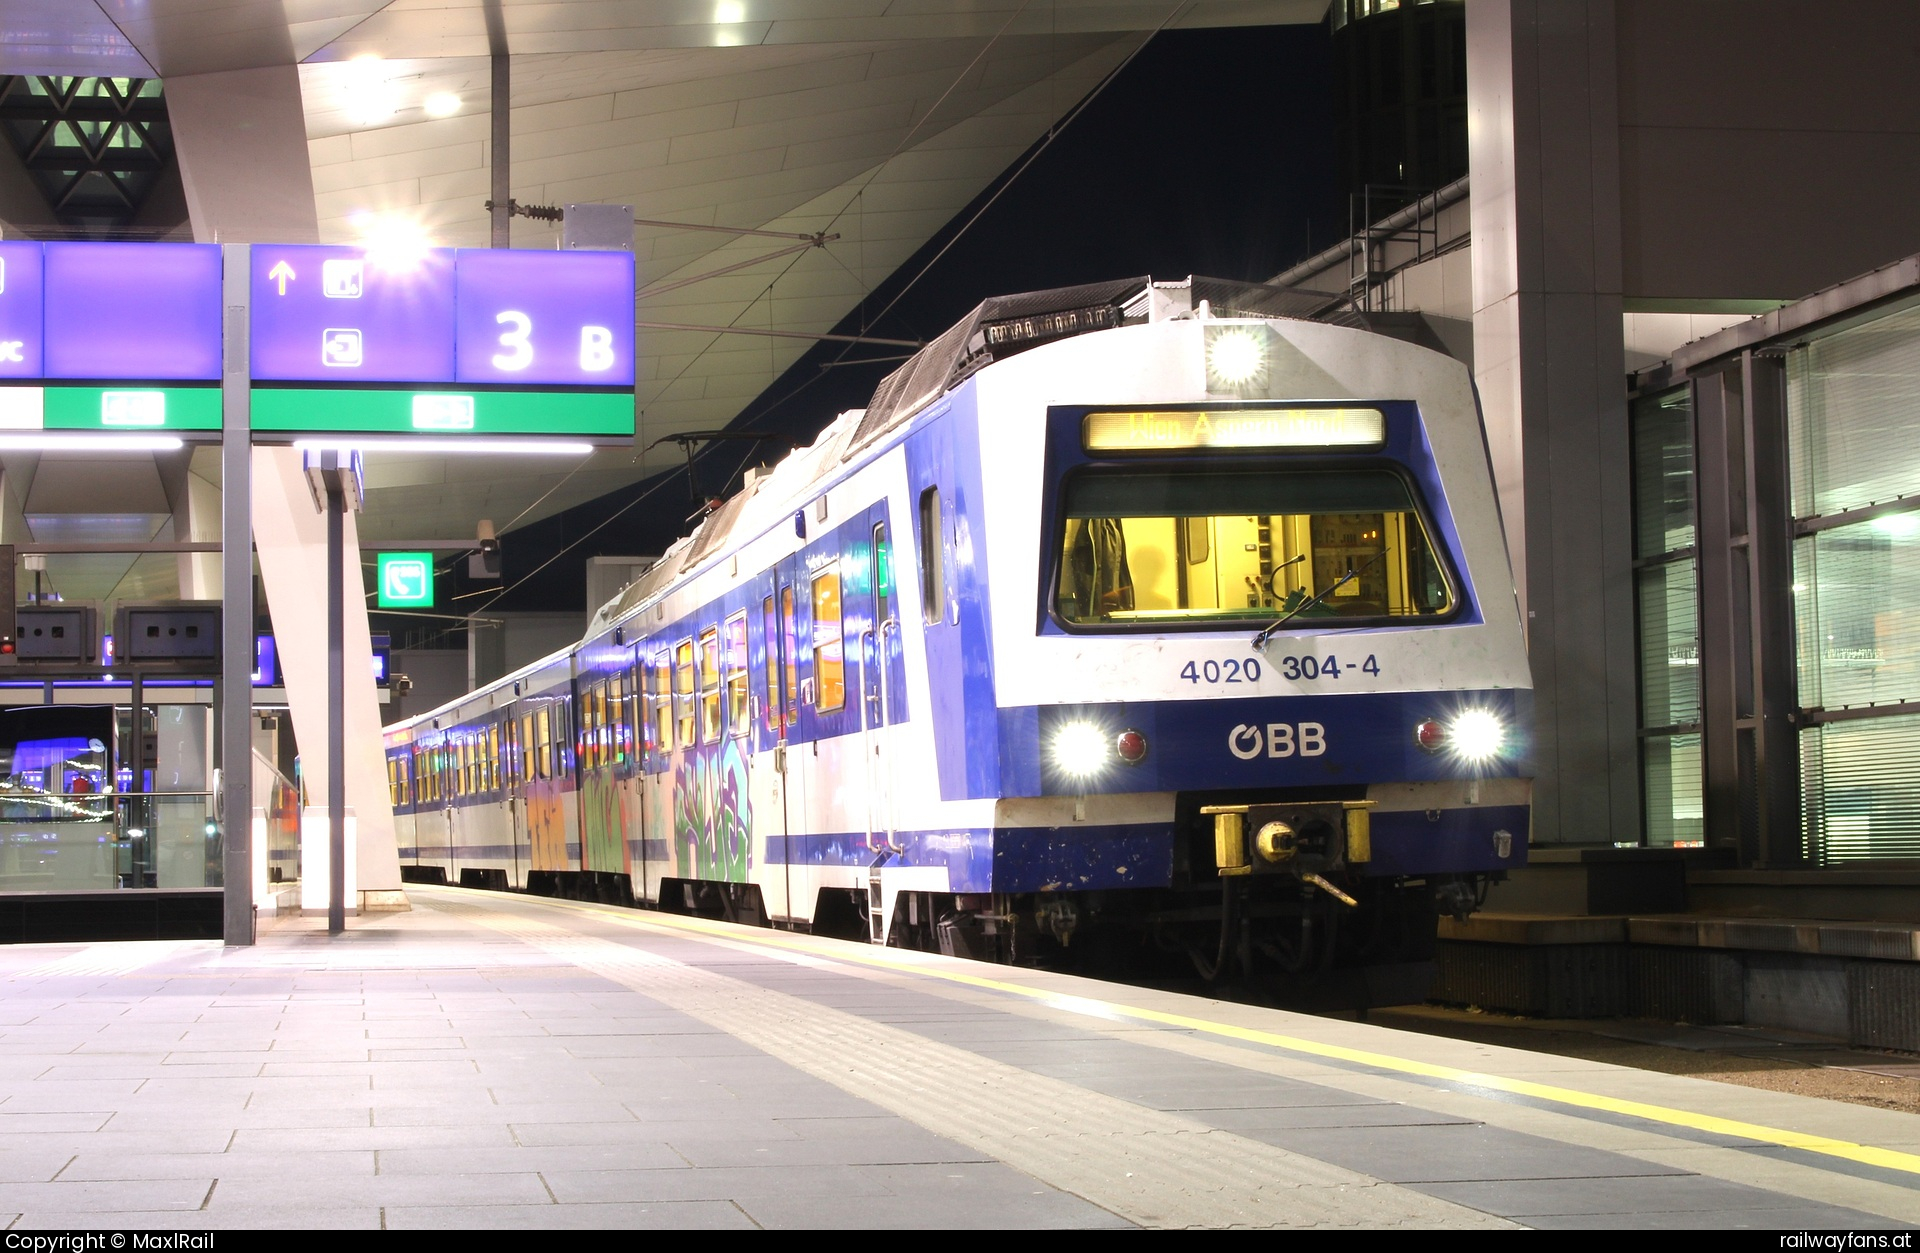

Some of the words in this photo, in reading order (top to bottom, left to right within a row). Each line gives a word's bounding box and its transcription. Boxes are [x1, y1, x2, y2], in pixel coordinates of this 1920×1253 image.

[492, 310, 534, 371] 3
[580, 325, 615, 371] B
[1129, 412, 1181, 441] Wien
[1180, 658, 1261, 684] 4020
[1282, 654, 1380, 681] 304-4
[1228, 722, 1327, 760] ÖBB
